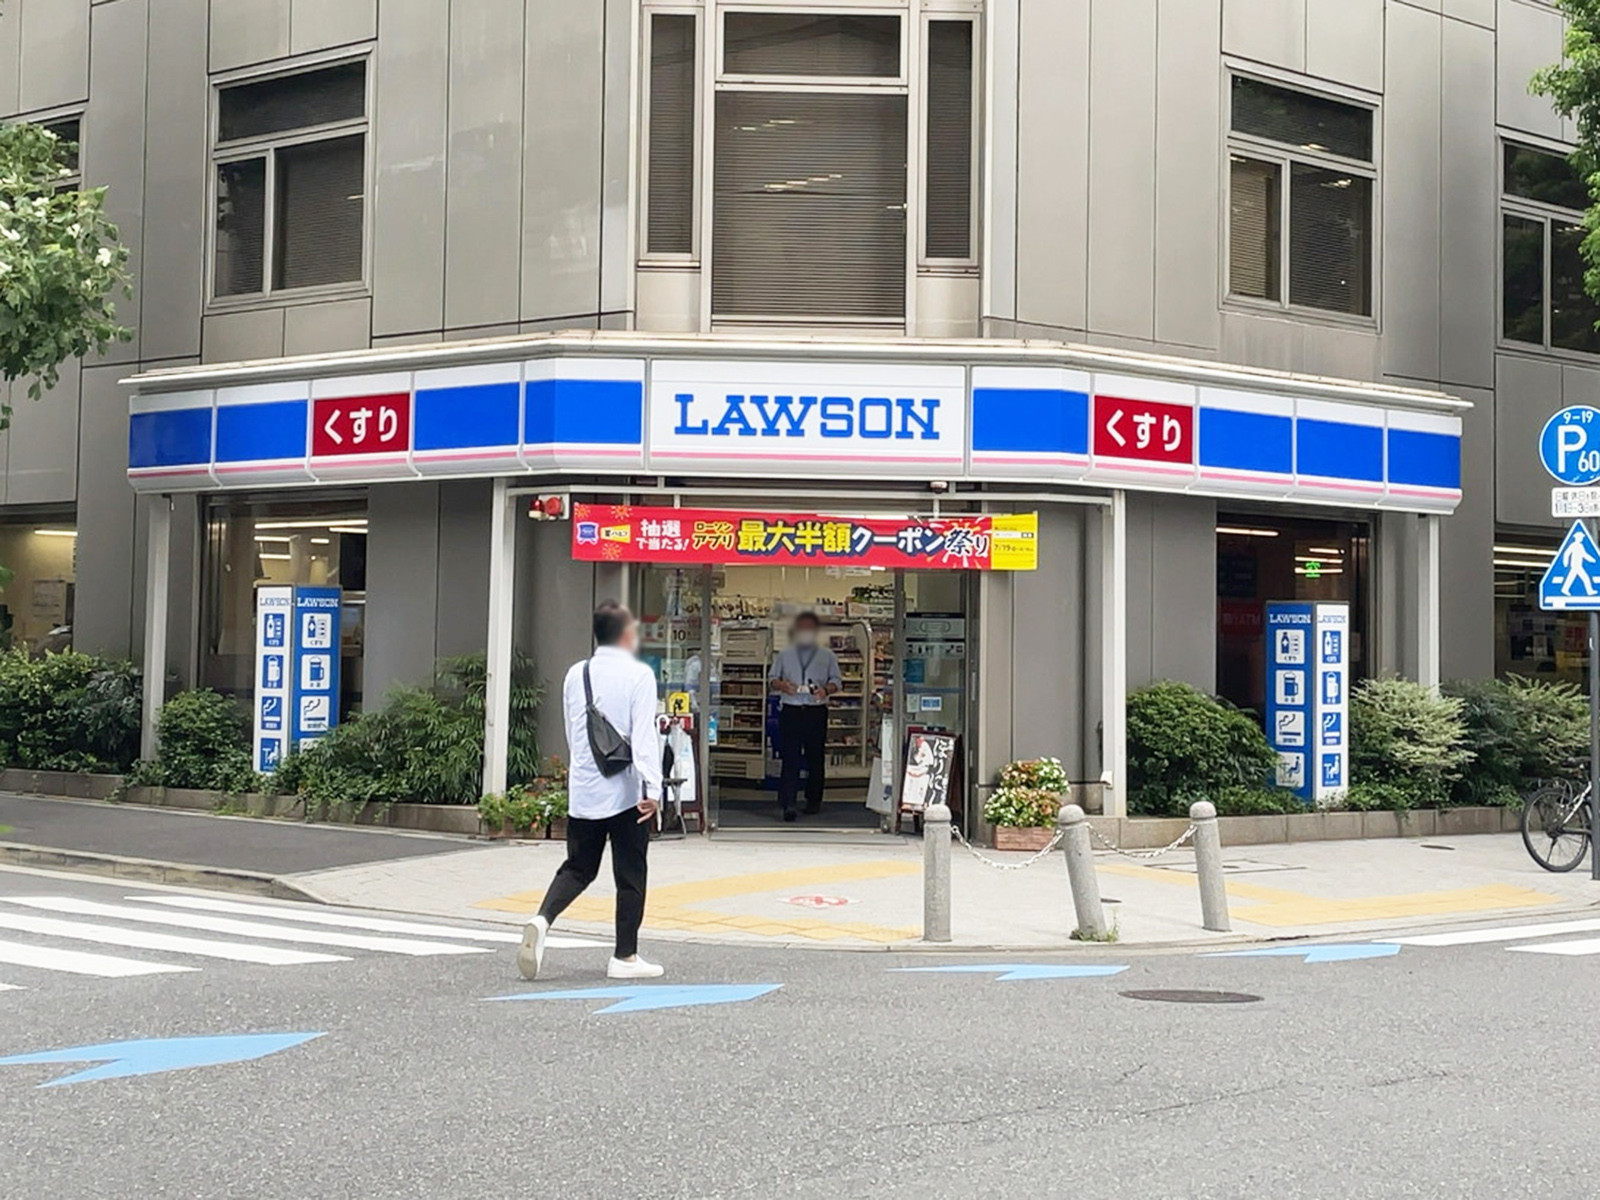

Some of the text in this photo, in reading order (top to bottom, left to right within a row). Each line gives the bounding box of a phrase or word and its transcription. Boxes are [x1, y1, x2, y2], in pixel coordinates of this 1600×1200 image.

[324, 406, 398, 445] くすり
[674, 393, 941, 440] LAWSON
[1563, 411, 1594, 424] 9-19
[1106, 409, 1182, 452] くすり
[1557, 424, 1588, 473] P
[1578, 450, 1600, 473] 60
[641, 518, 681, 537] 抽選
[692, 533, 735, 550] アプリ
[297, 597, 339, 607] LAWSON
[1269, 613, 1311, 624] LAWSON
